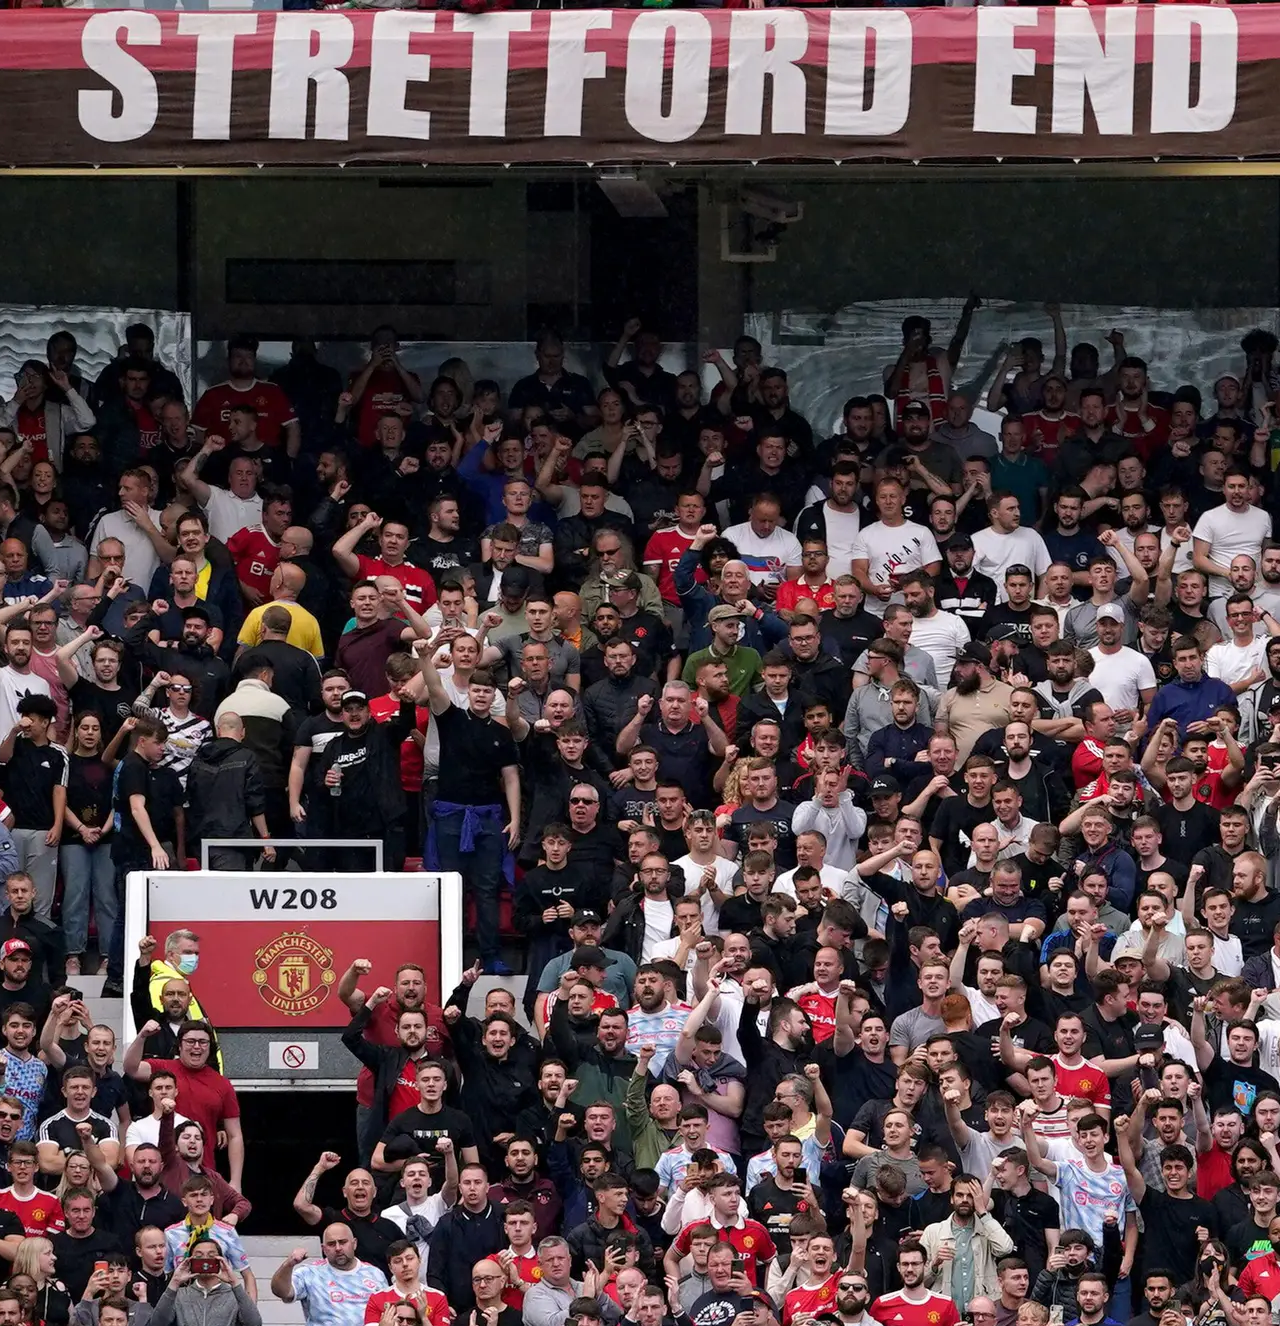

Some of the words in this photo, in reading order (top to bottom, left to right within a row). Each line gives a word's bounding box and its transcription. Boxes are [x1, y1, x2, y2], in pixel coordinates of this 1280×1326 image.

[77, 8, 912, 142] STRETFORD
[973, 5, 1239, 136] END
[250, 888, 338, 910] W208
[261, 934, 331, 967] MANCHESTER
[271, 990, 326, 1012] UNITED
[808, 1012, 836, 1026] SHA
